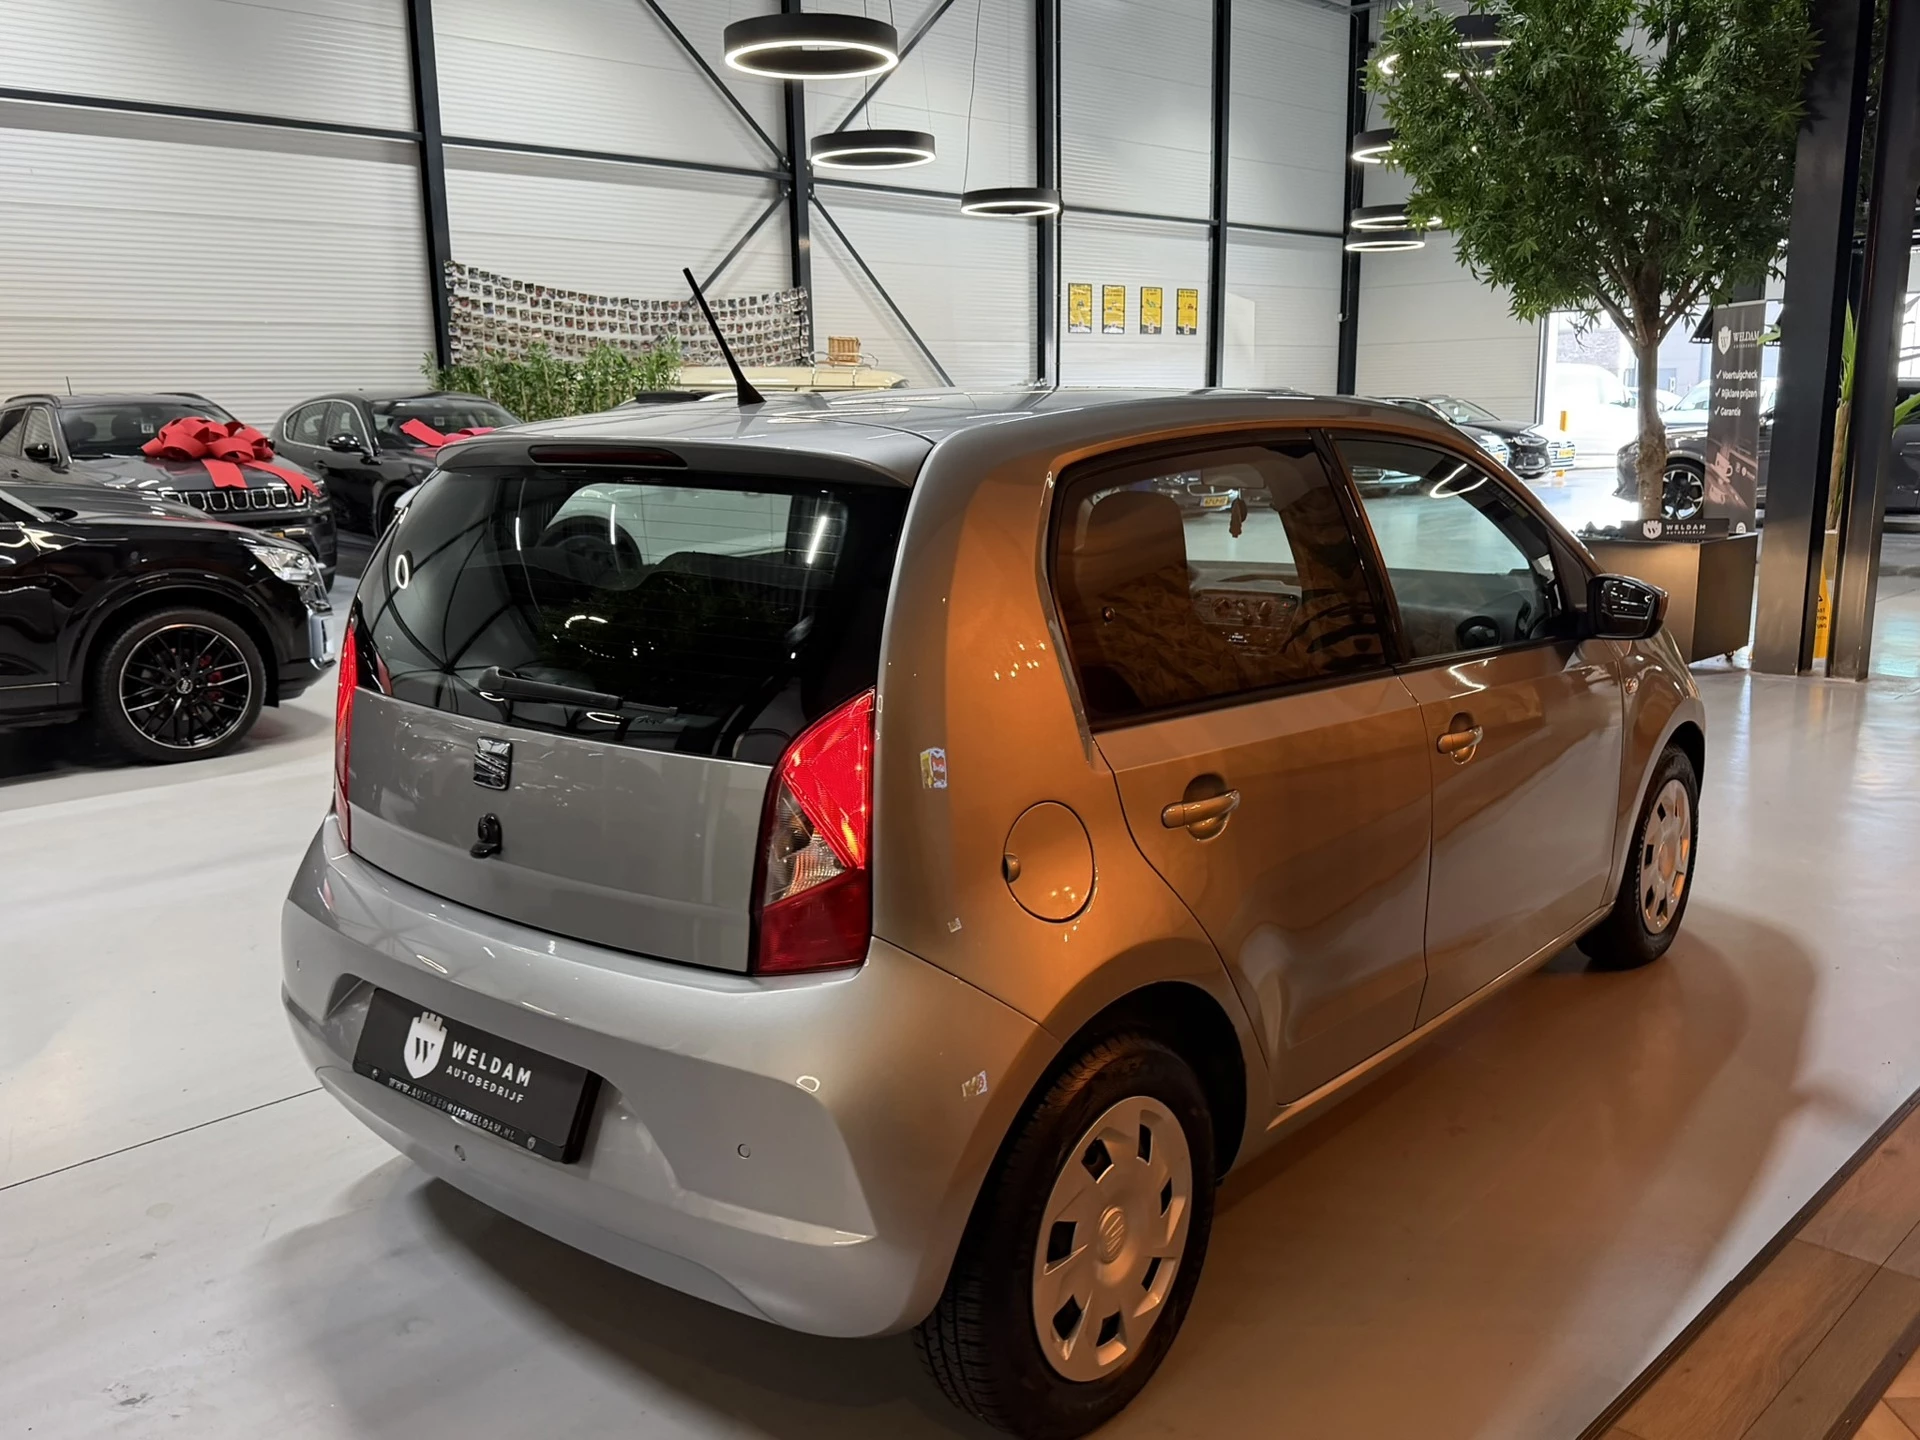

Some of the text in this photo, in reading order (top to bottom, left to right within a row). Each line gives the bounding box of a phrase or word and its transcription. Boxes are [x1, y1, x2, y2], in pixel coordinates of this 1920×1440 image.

[1665, 523, 1706, 531] WELDAM
[451, 1041, 532, 1087] WELDAM
[446, 1065, 524, 1103] AUTOBEDRIJF
